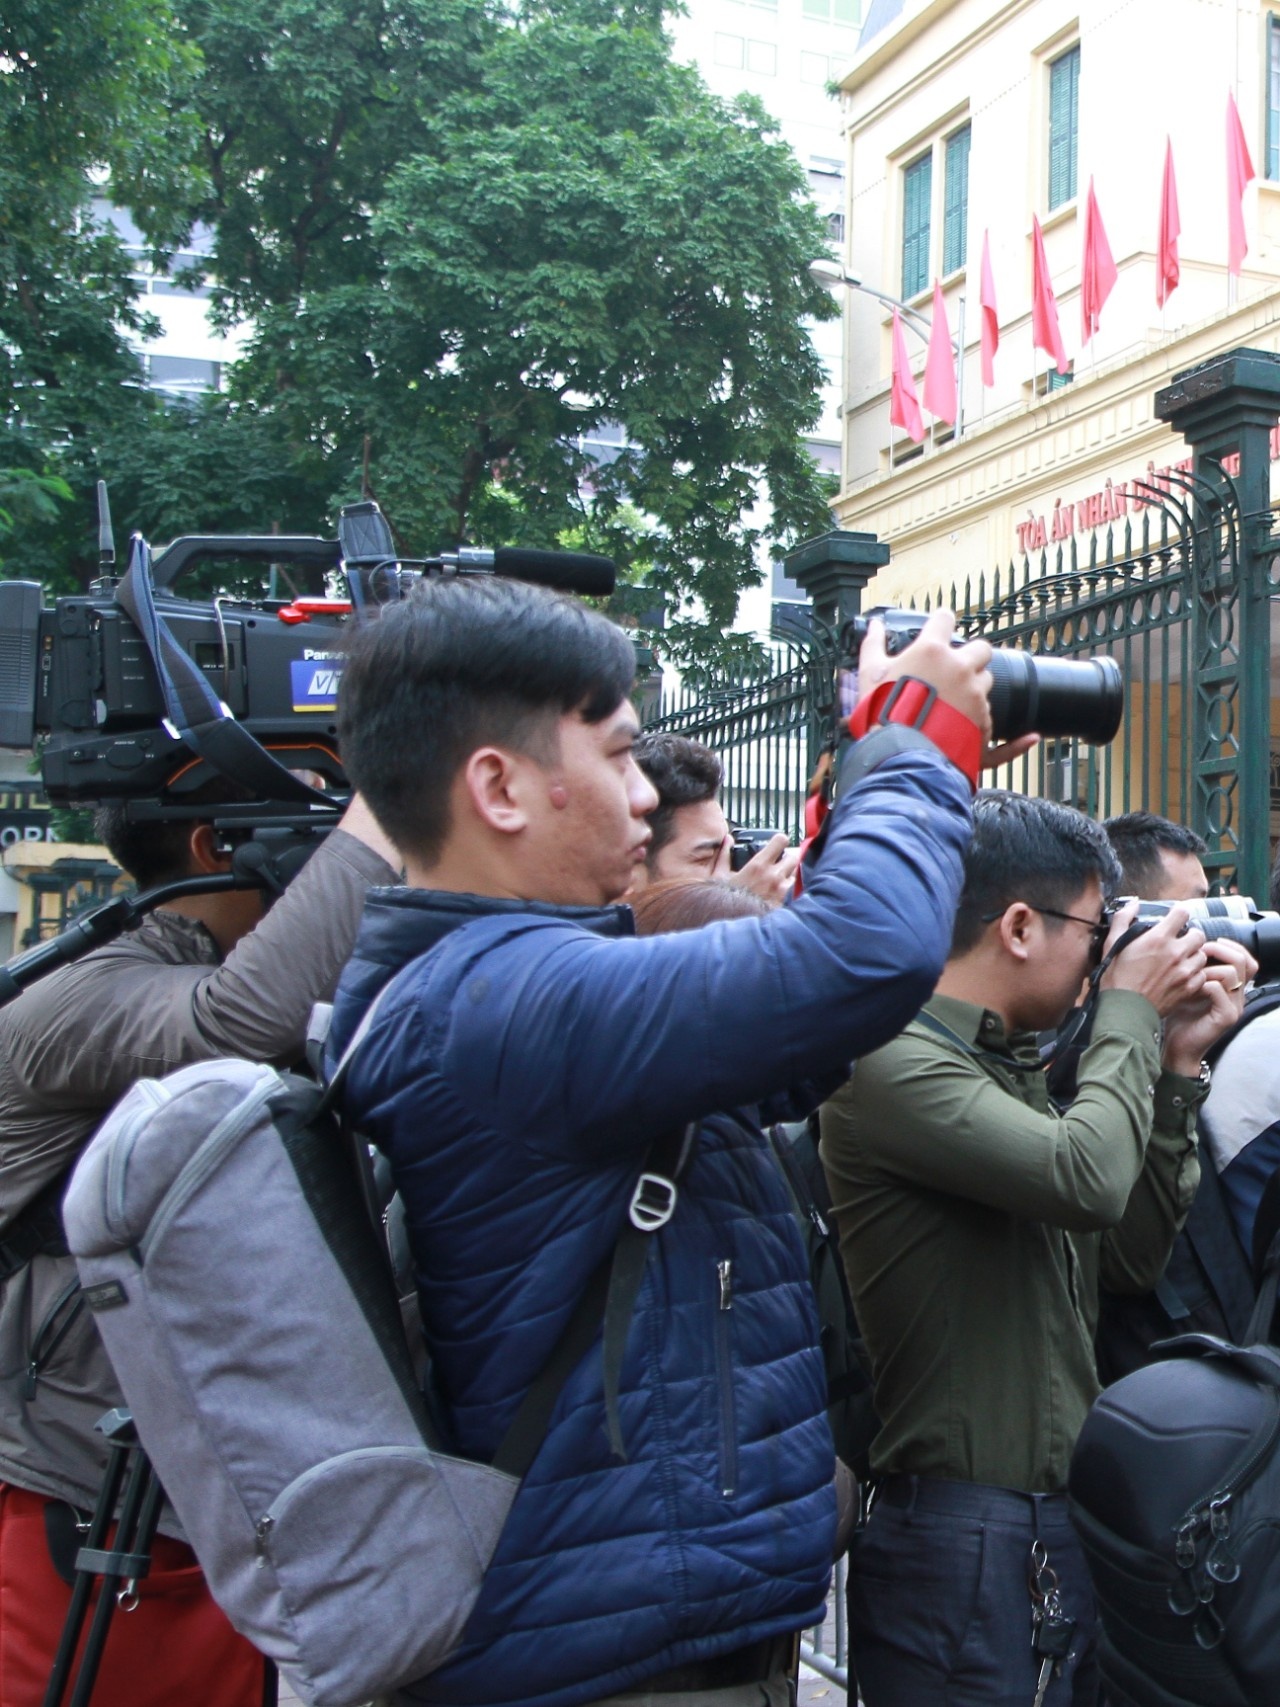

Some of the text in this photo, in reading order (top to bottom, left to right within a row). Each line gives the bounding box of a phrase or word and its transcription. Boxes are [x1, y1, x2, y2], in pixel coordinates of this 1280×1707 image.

[1016, 509, 1047, 554] TÒA
[1050, 498, 1074, 543] ÁN
[1077, 477, 1127, 533] NHÂN
[1131, 461, 1171, 513] DÂN
